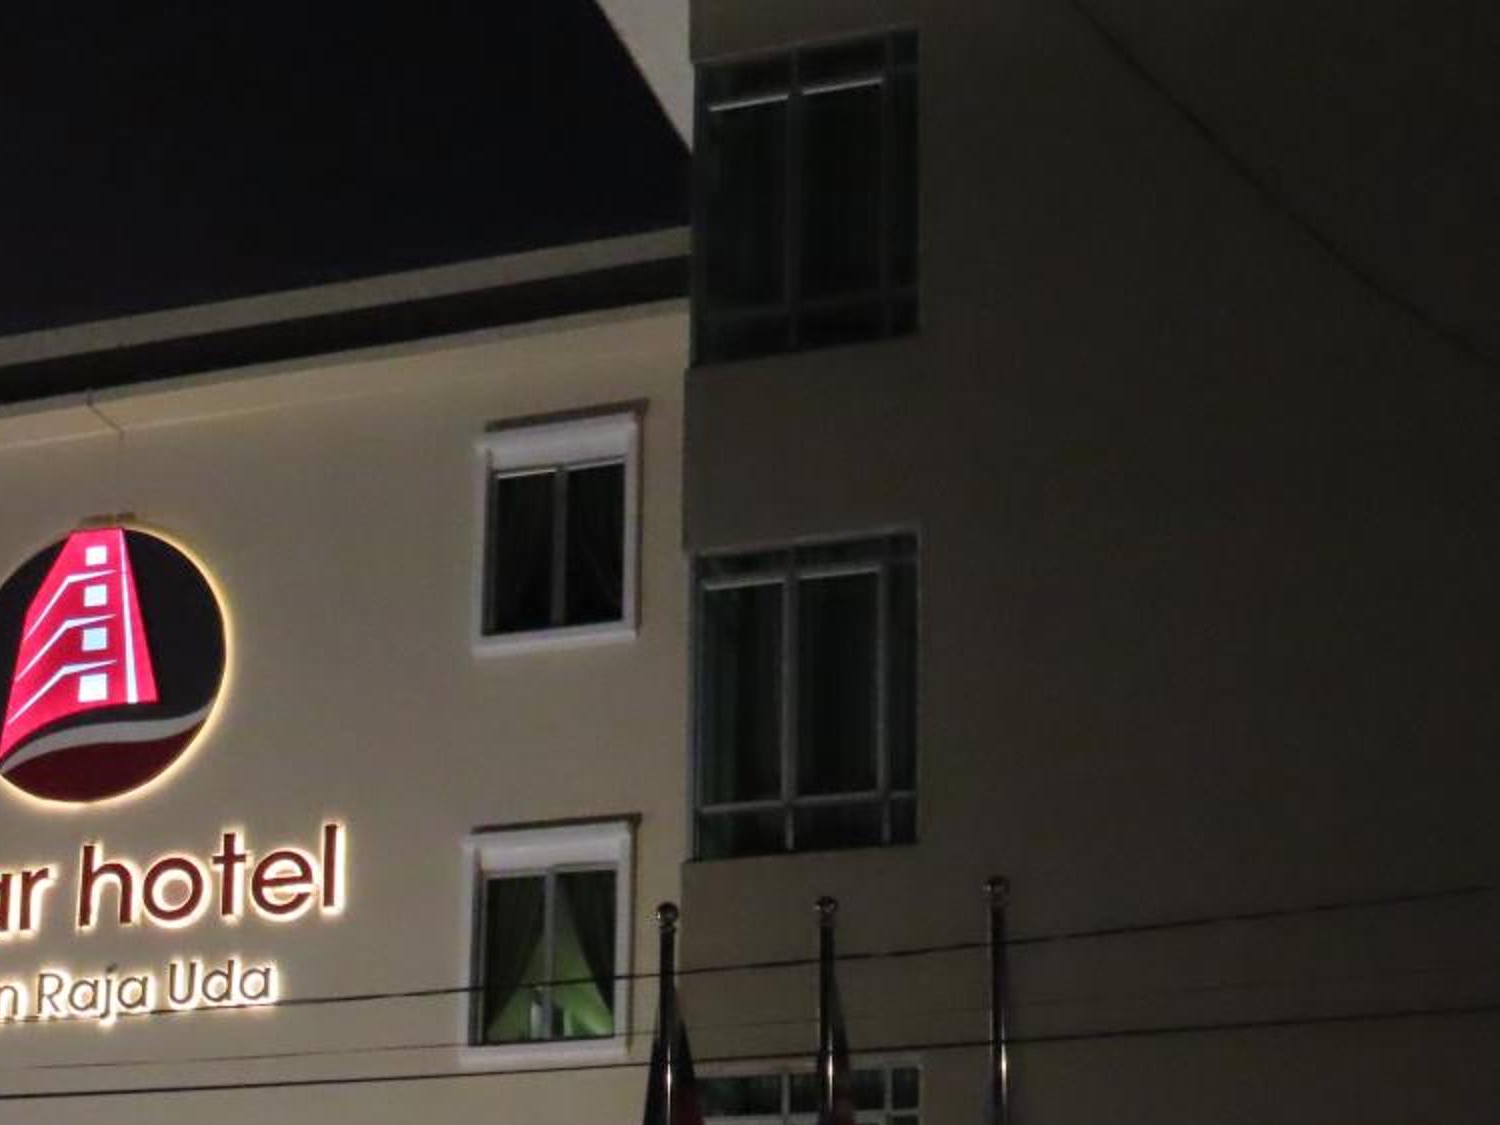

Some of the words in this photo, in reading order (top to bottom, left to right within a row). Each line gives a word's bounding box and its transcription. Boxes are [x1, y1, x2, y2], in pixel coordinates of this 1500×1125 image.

[76, 822, 343, 927] hotel
[36, 964, 150, 1017] Raja
[167, 960, 272, 1005] Uda
